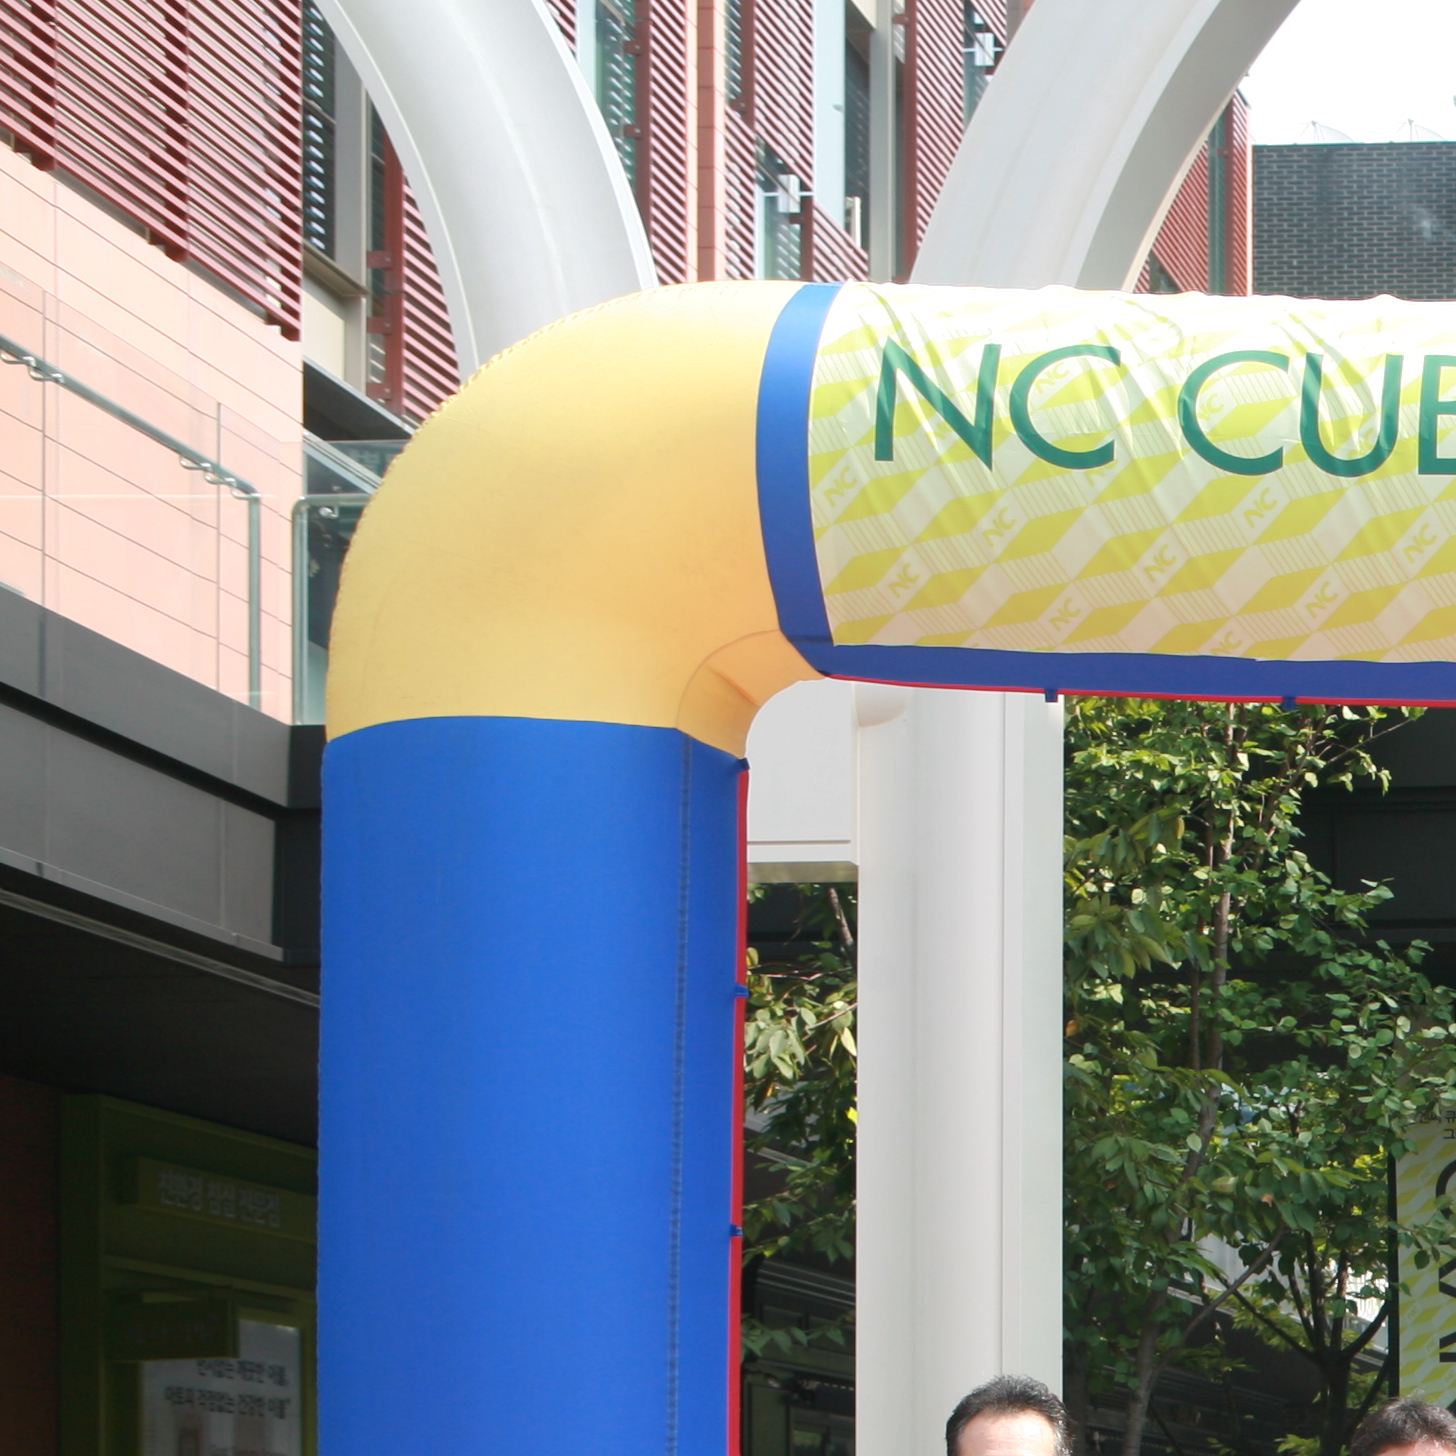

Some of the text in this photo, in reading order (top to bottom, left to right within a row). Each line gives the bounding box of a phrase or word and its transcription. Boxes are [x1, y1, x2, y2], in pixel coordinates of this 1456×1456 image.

[1033, 361, 1070, 395] NC
[874, 335, 1122, 472] NC
[823, 465, 859, 507] NC
[1242, 487, 1280, 527] NC
[981, 506, 1017, 547] NC
[1403, 523, 1438, 564] NC
[888, 562, 921, 599] NC
[1143, 544, 1178, 582] NC
[1048, 597, 1082, 632] NC
[1304, 581, 1338, 619] NC
[1212, 630, 1246, 655] NC
